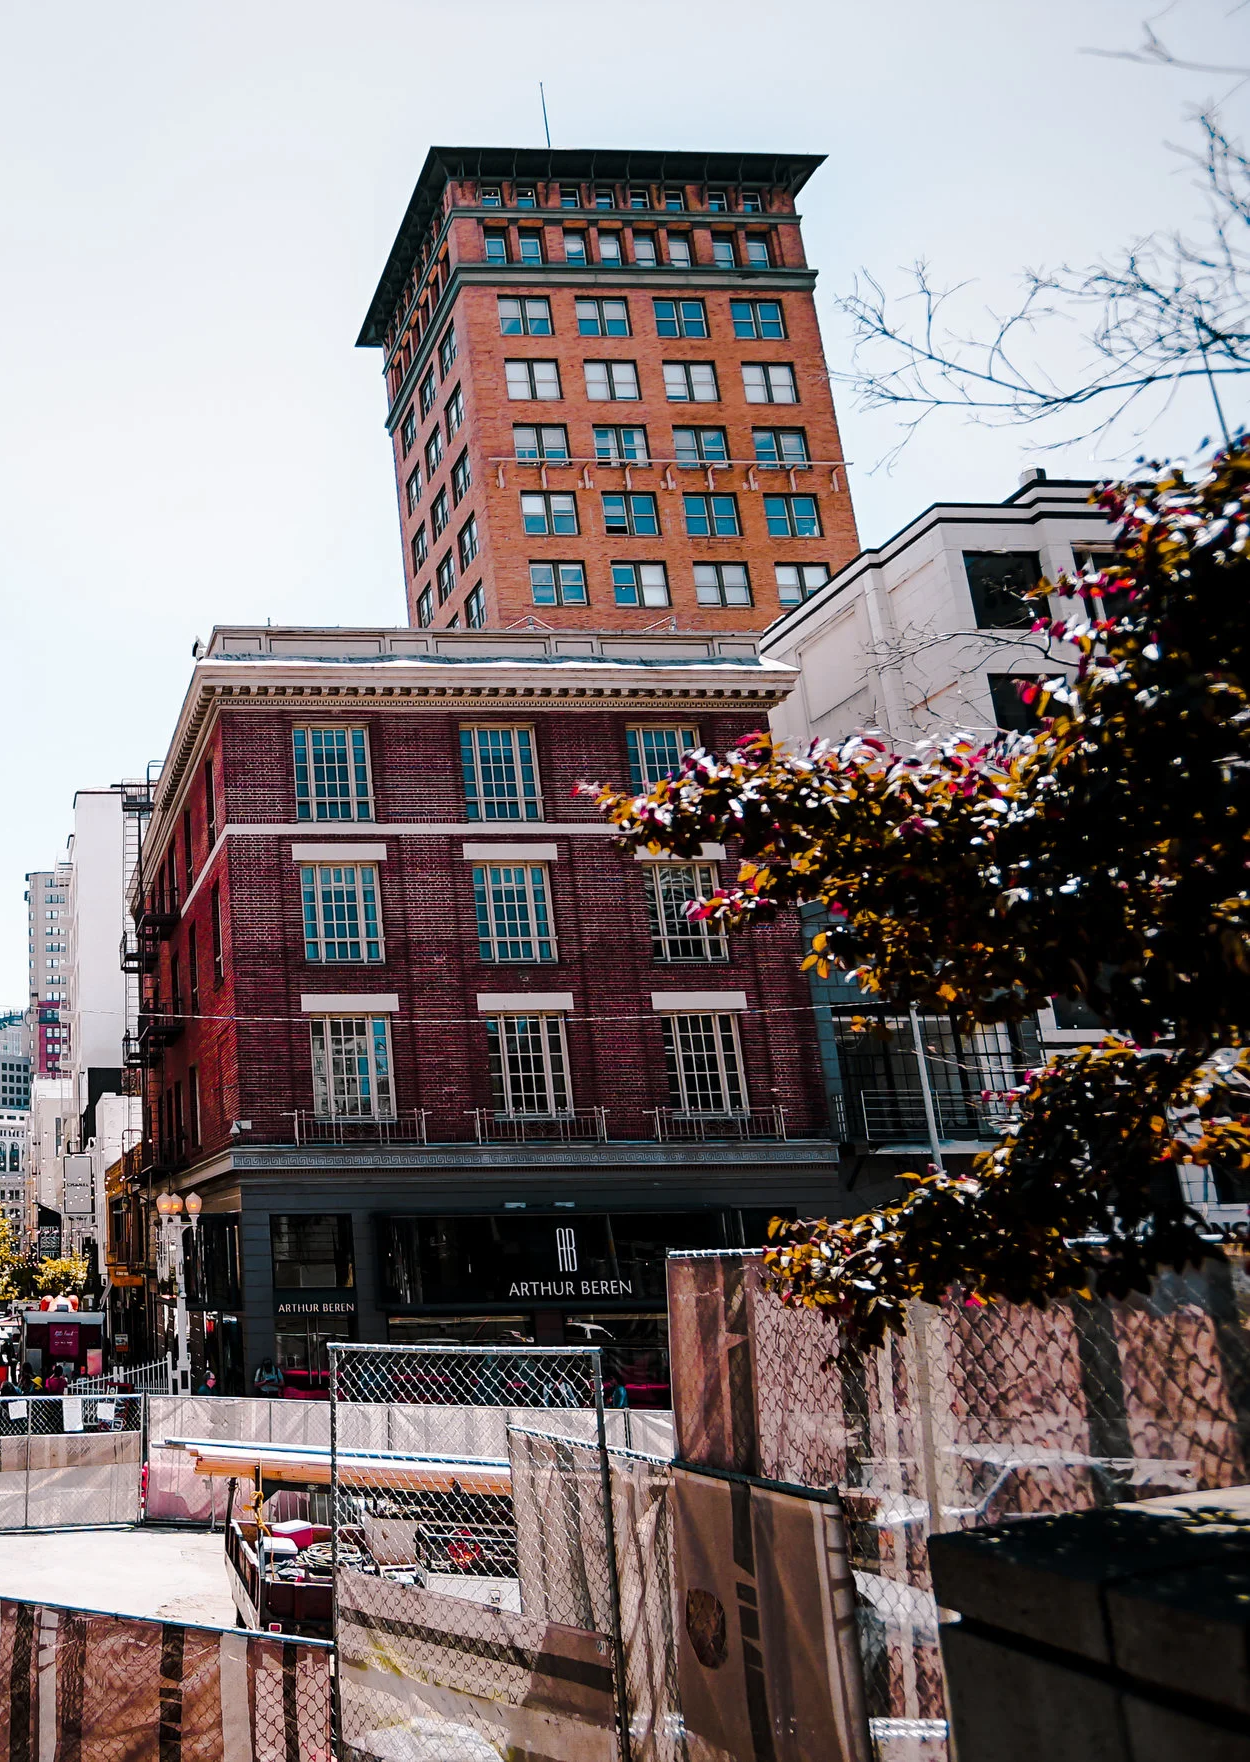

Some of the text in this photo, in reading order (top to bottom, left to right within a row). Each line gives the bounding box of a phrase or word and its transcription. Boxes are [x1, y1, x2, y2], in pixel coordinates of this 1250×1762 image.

[556, 1228, 578, 1272] AB
[509, 1280, 633, 1297] ARTHUR BEREN
[278, 1303, 355, 1313] ARTHUR BEREN
